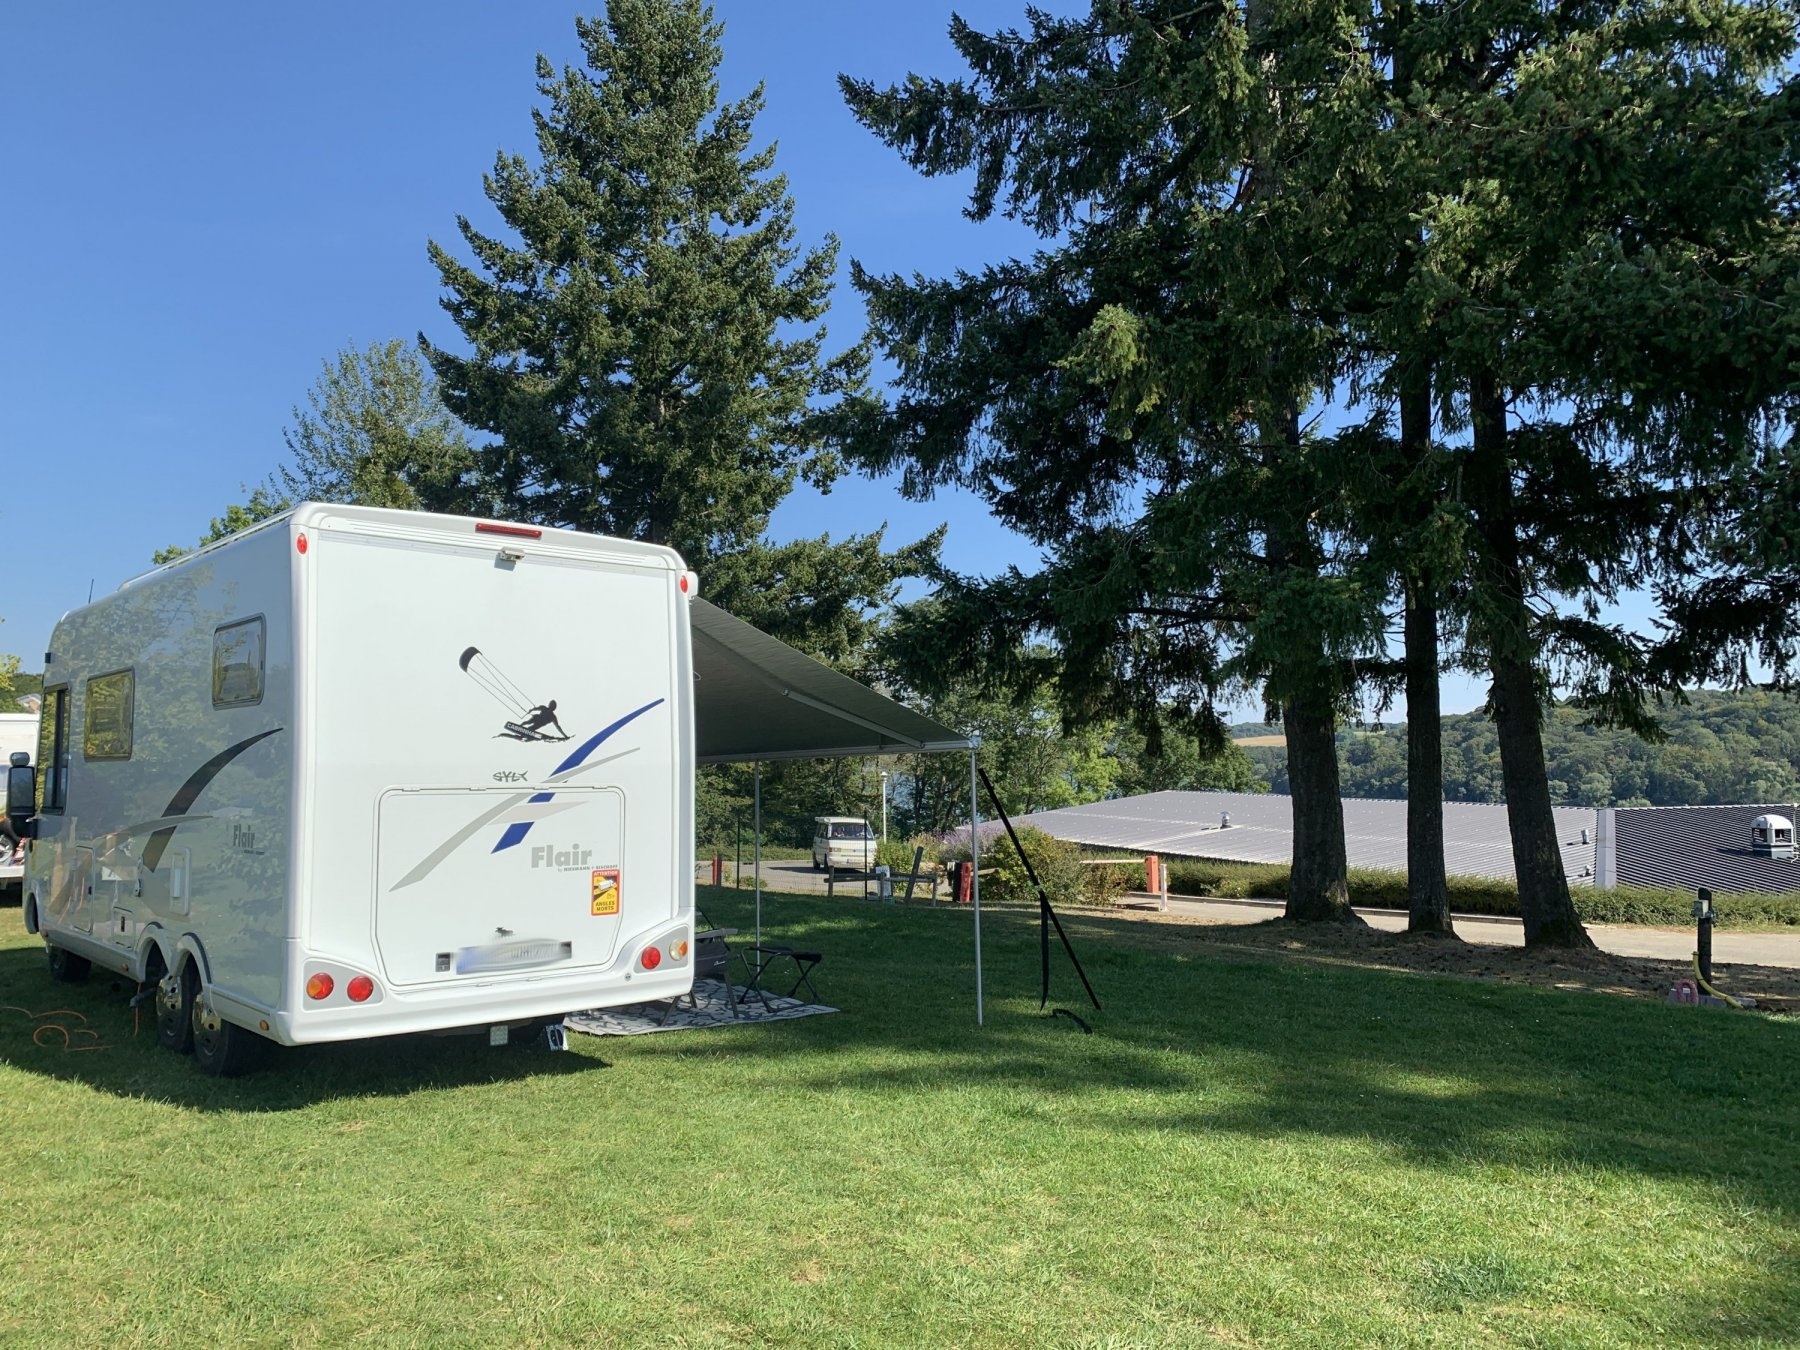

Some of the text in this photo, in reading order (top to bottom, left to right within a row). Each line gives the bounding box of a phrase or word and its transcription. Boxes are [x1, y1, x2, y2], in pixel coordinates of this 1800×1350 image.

[507, 723, 536, 738] CABRINHA
[232, 823, 255, 849] Flair
[531, 843, 593, 868] Flair
